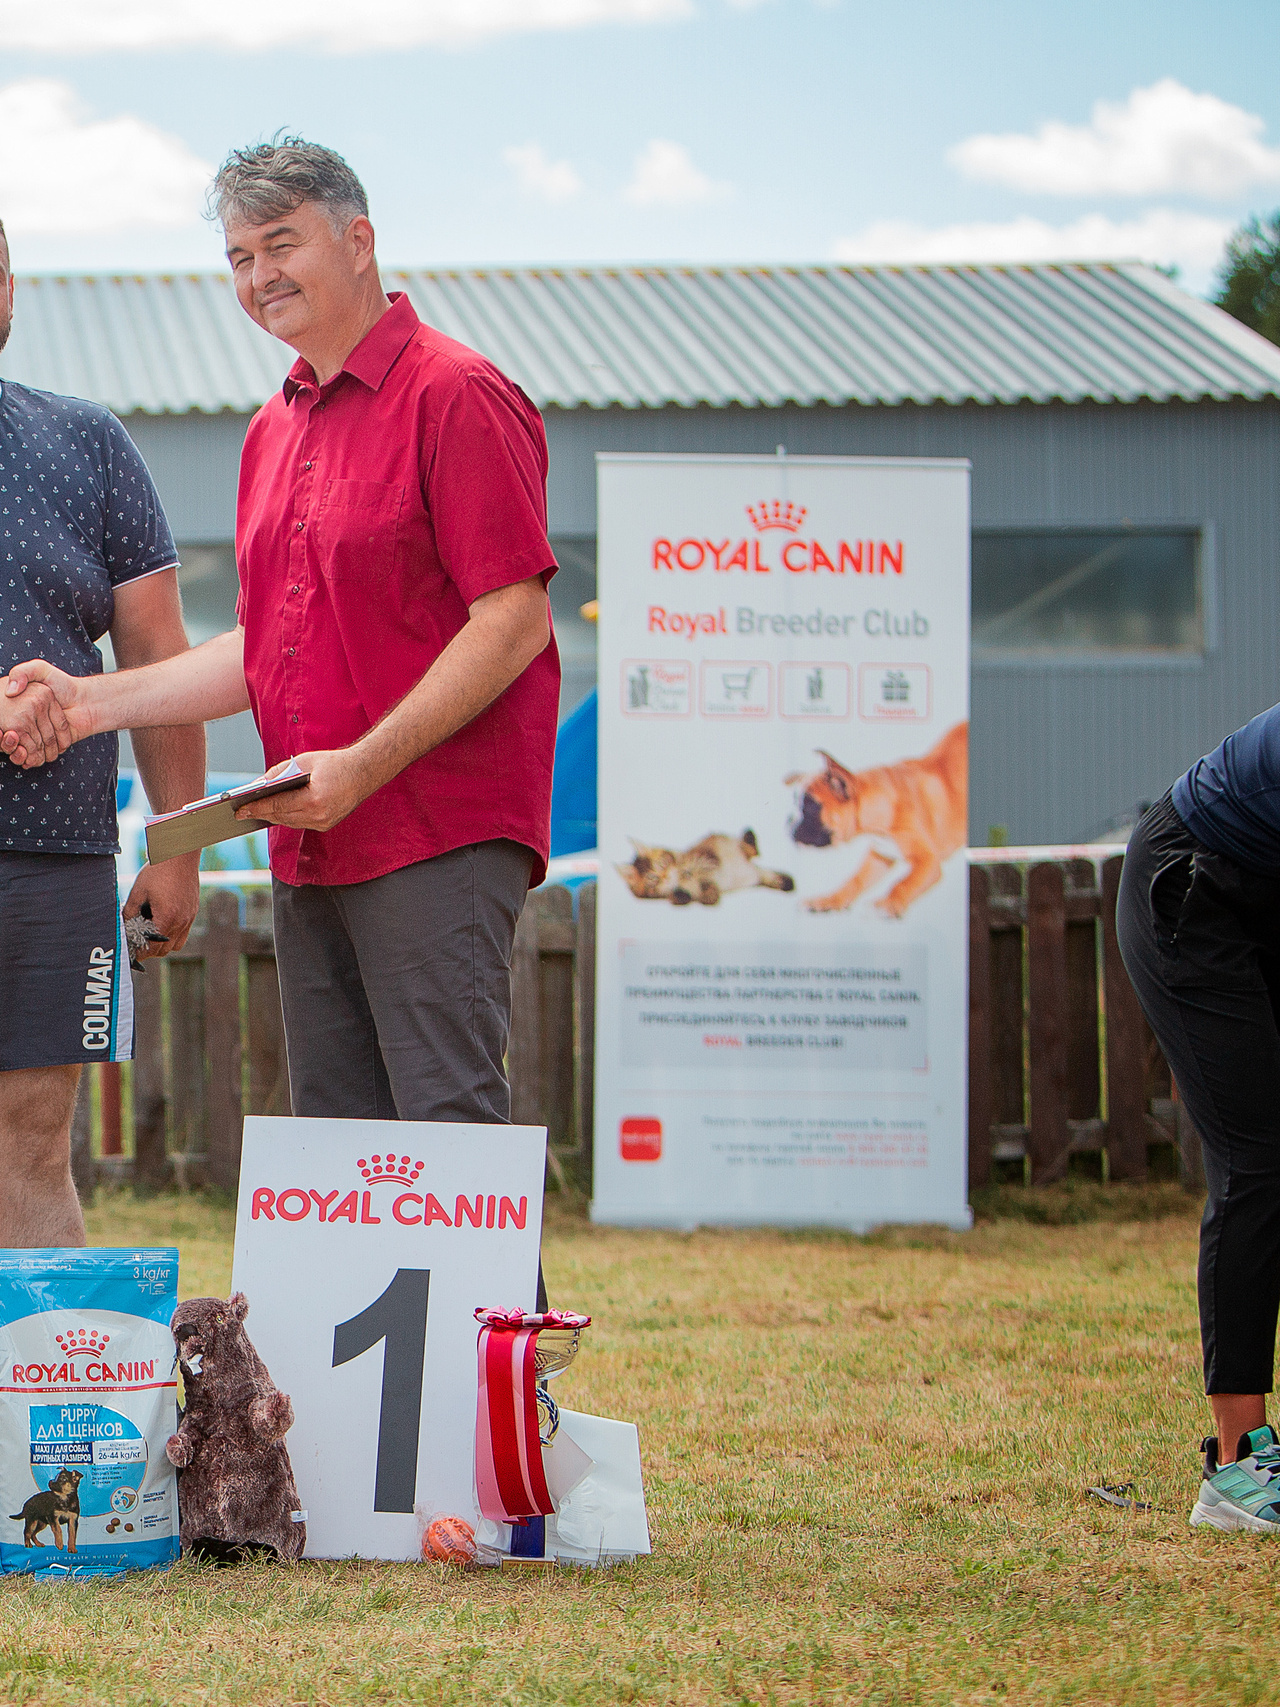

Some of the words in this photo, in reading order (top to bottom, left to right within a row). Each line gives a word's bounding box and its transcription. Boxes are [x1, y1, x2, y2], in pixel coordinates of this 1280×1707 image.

[652, 538, 770, 572] ROYAL
[782, 540, 903, 574] CANIN
[648, 605, 727, 640] Royal
[736, 606, 856, 637] Breeder
[863, 608, 930, 638] Club
[82, 946, 114, 1050] COLMAR
[252, 1187, 381, 1225] ROYAL
[392, 1192, 527, 1230] CANIN
[133, 1266, 140, 1279] 3
[12, 1362, 81, 1384] ROYAL
[332, 1267, 431, 1514] 1
[61, 1408, 97, 1422] PUPPY
[36, 1424, 64, 1440] ДЛЯ
[68, 1422, 123, 1439] ЩЕНКОВ
[33, 1453, 61, 1463] КРУПНЫХ
[61, 1453, 92, 1463] РАЗМЕРОВ
[55, 1445, 68, 1454] ДЛЯ
[68, 1444, 90, 1453] СОБАК
[98, 1451, 119, 1460] 26-44
